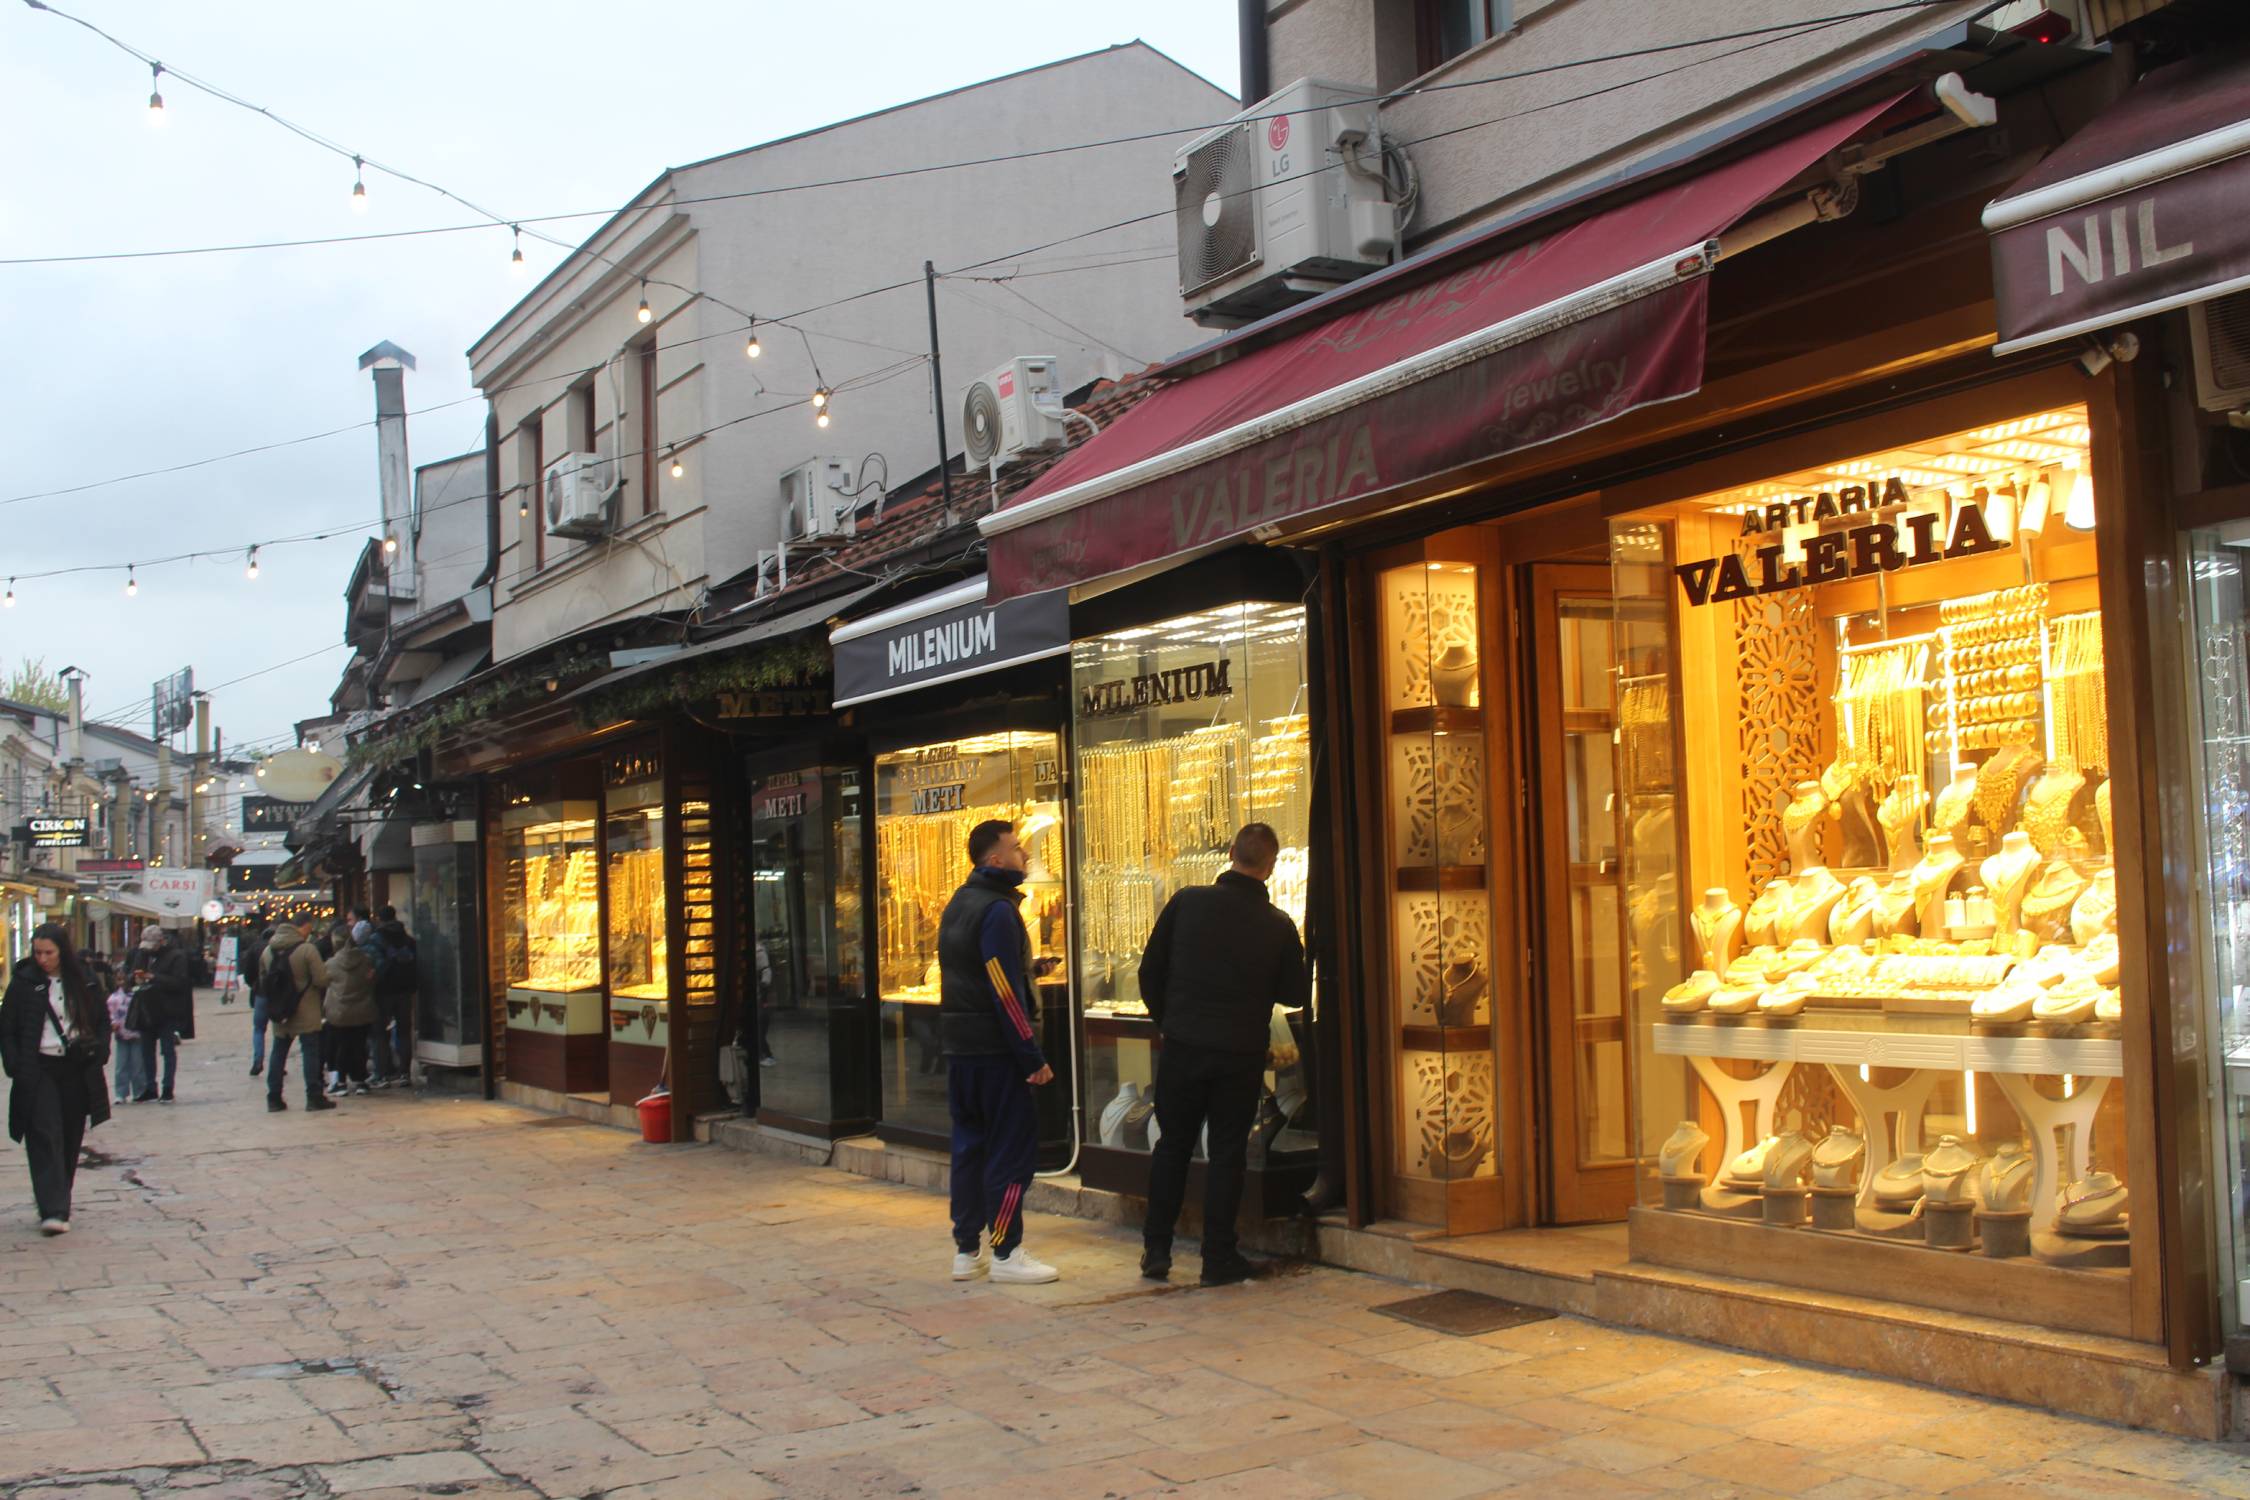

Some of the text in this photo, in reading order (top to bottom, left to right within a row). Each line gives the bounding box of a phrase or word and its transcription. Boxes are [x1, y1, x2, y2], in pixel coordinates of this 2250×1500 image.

[1272, 154, 1290, 177] LG
[2047, 198, 2193, 295] NIL
[1501, 356, 1627, 421] jewelry
[1171, 424, 1379, 546] VALERIA
[1741, 477, 1910, 537] ARTARIA
[1674, 505, 2012, 607] VALERIA
[888, 611, 996, 677] MILENIUM
[1080, 659, 1232, 717] MILENIUM
[30, 819, 86, 831] CIRKON
[765, 794, 803, 819] METI
[911, 784, 964, 815] METI
